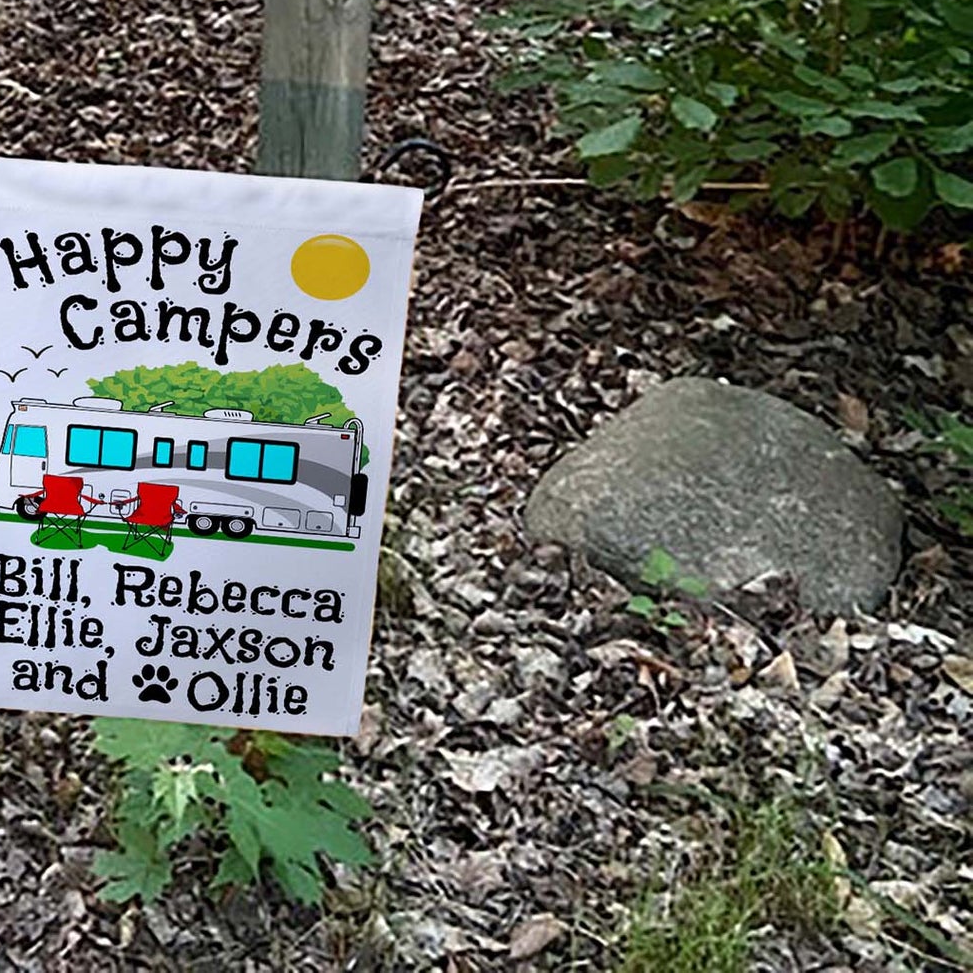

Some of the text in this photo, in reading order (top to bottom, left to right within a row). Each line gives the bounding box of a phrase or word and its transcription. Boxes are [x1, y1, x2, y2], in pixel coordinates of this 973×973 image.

[0, 224, 239, 295] Happy
[59, 294, 383, 375] Campers
[111, 562, 346, 624] Rebecca
[135, 614, 336, 672] Jaxson
[11, 658, 309, 716] and Ollie
